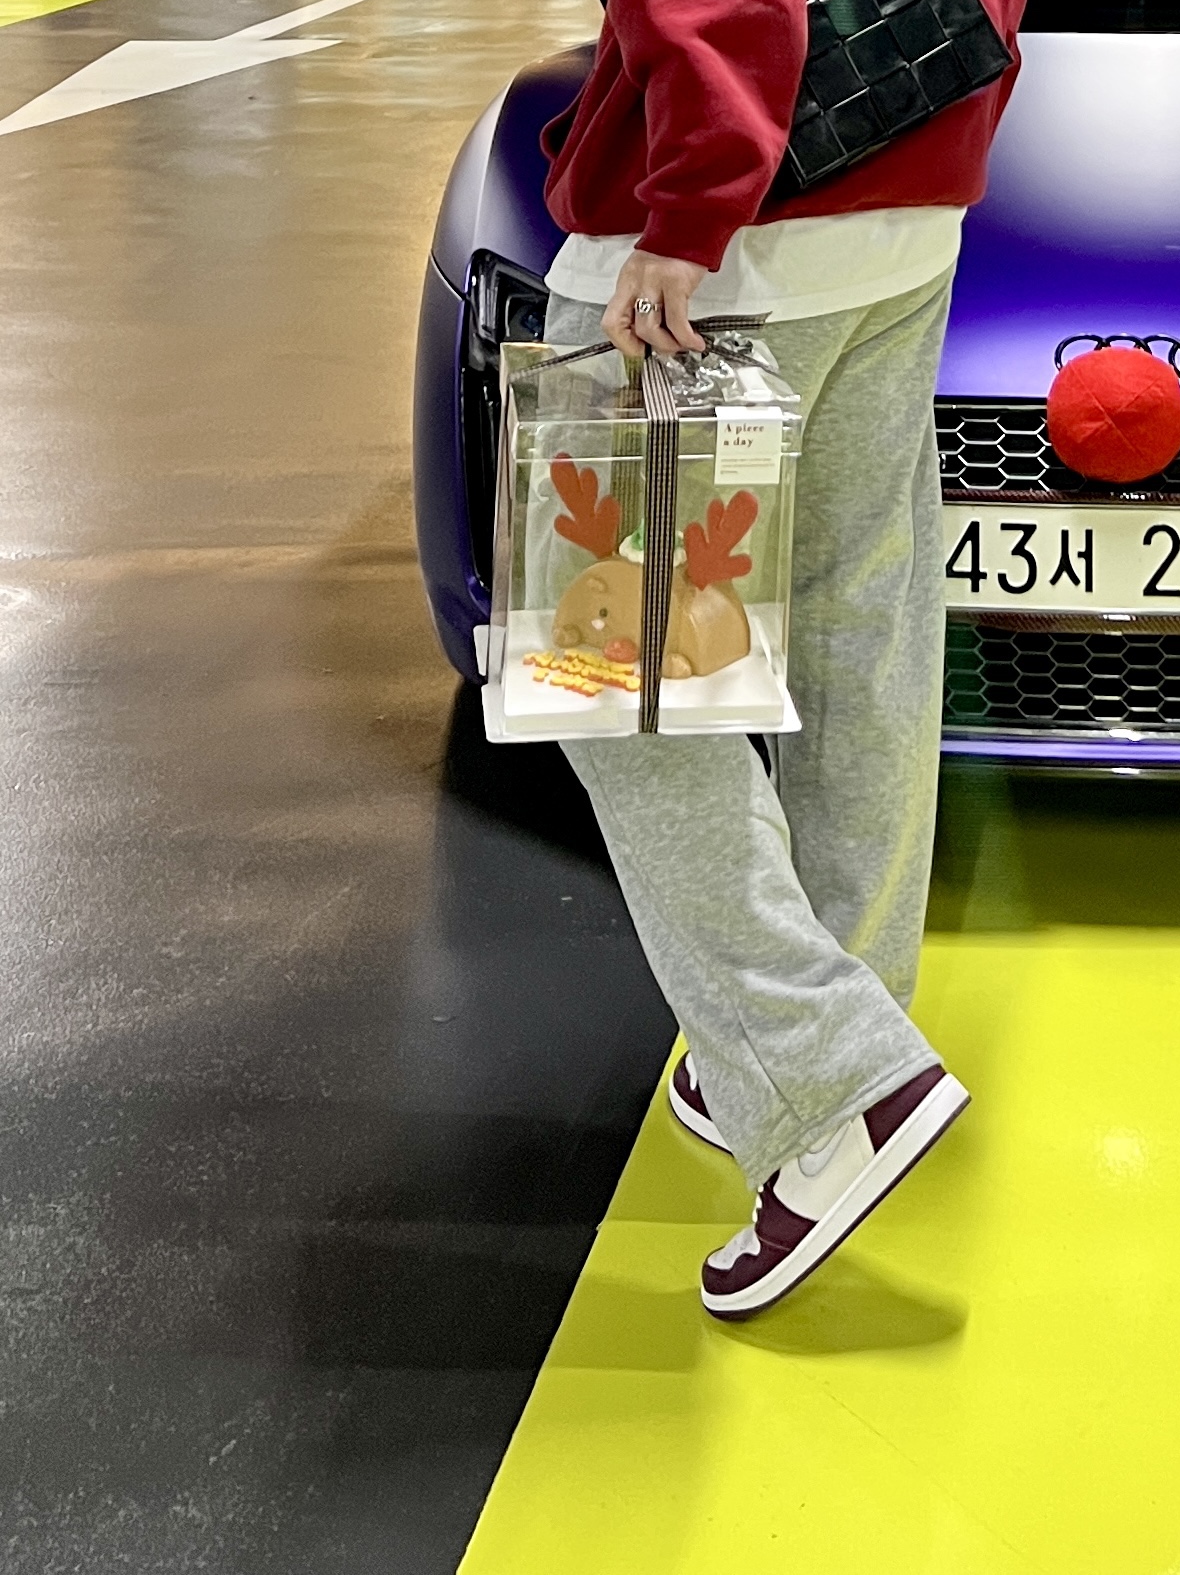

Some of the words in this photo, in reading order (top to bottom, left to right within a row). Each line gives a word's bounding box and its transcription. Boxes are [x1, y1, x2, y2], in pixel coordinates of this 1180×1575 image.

[725, 423, 732, 433] A
[735, 422, 765, 435] piece
[733, 437, 754, 448] day
[945, 520, 1094, 594] 43서
